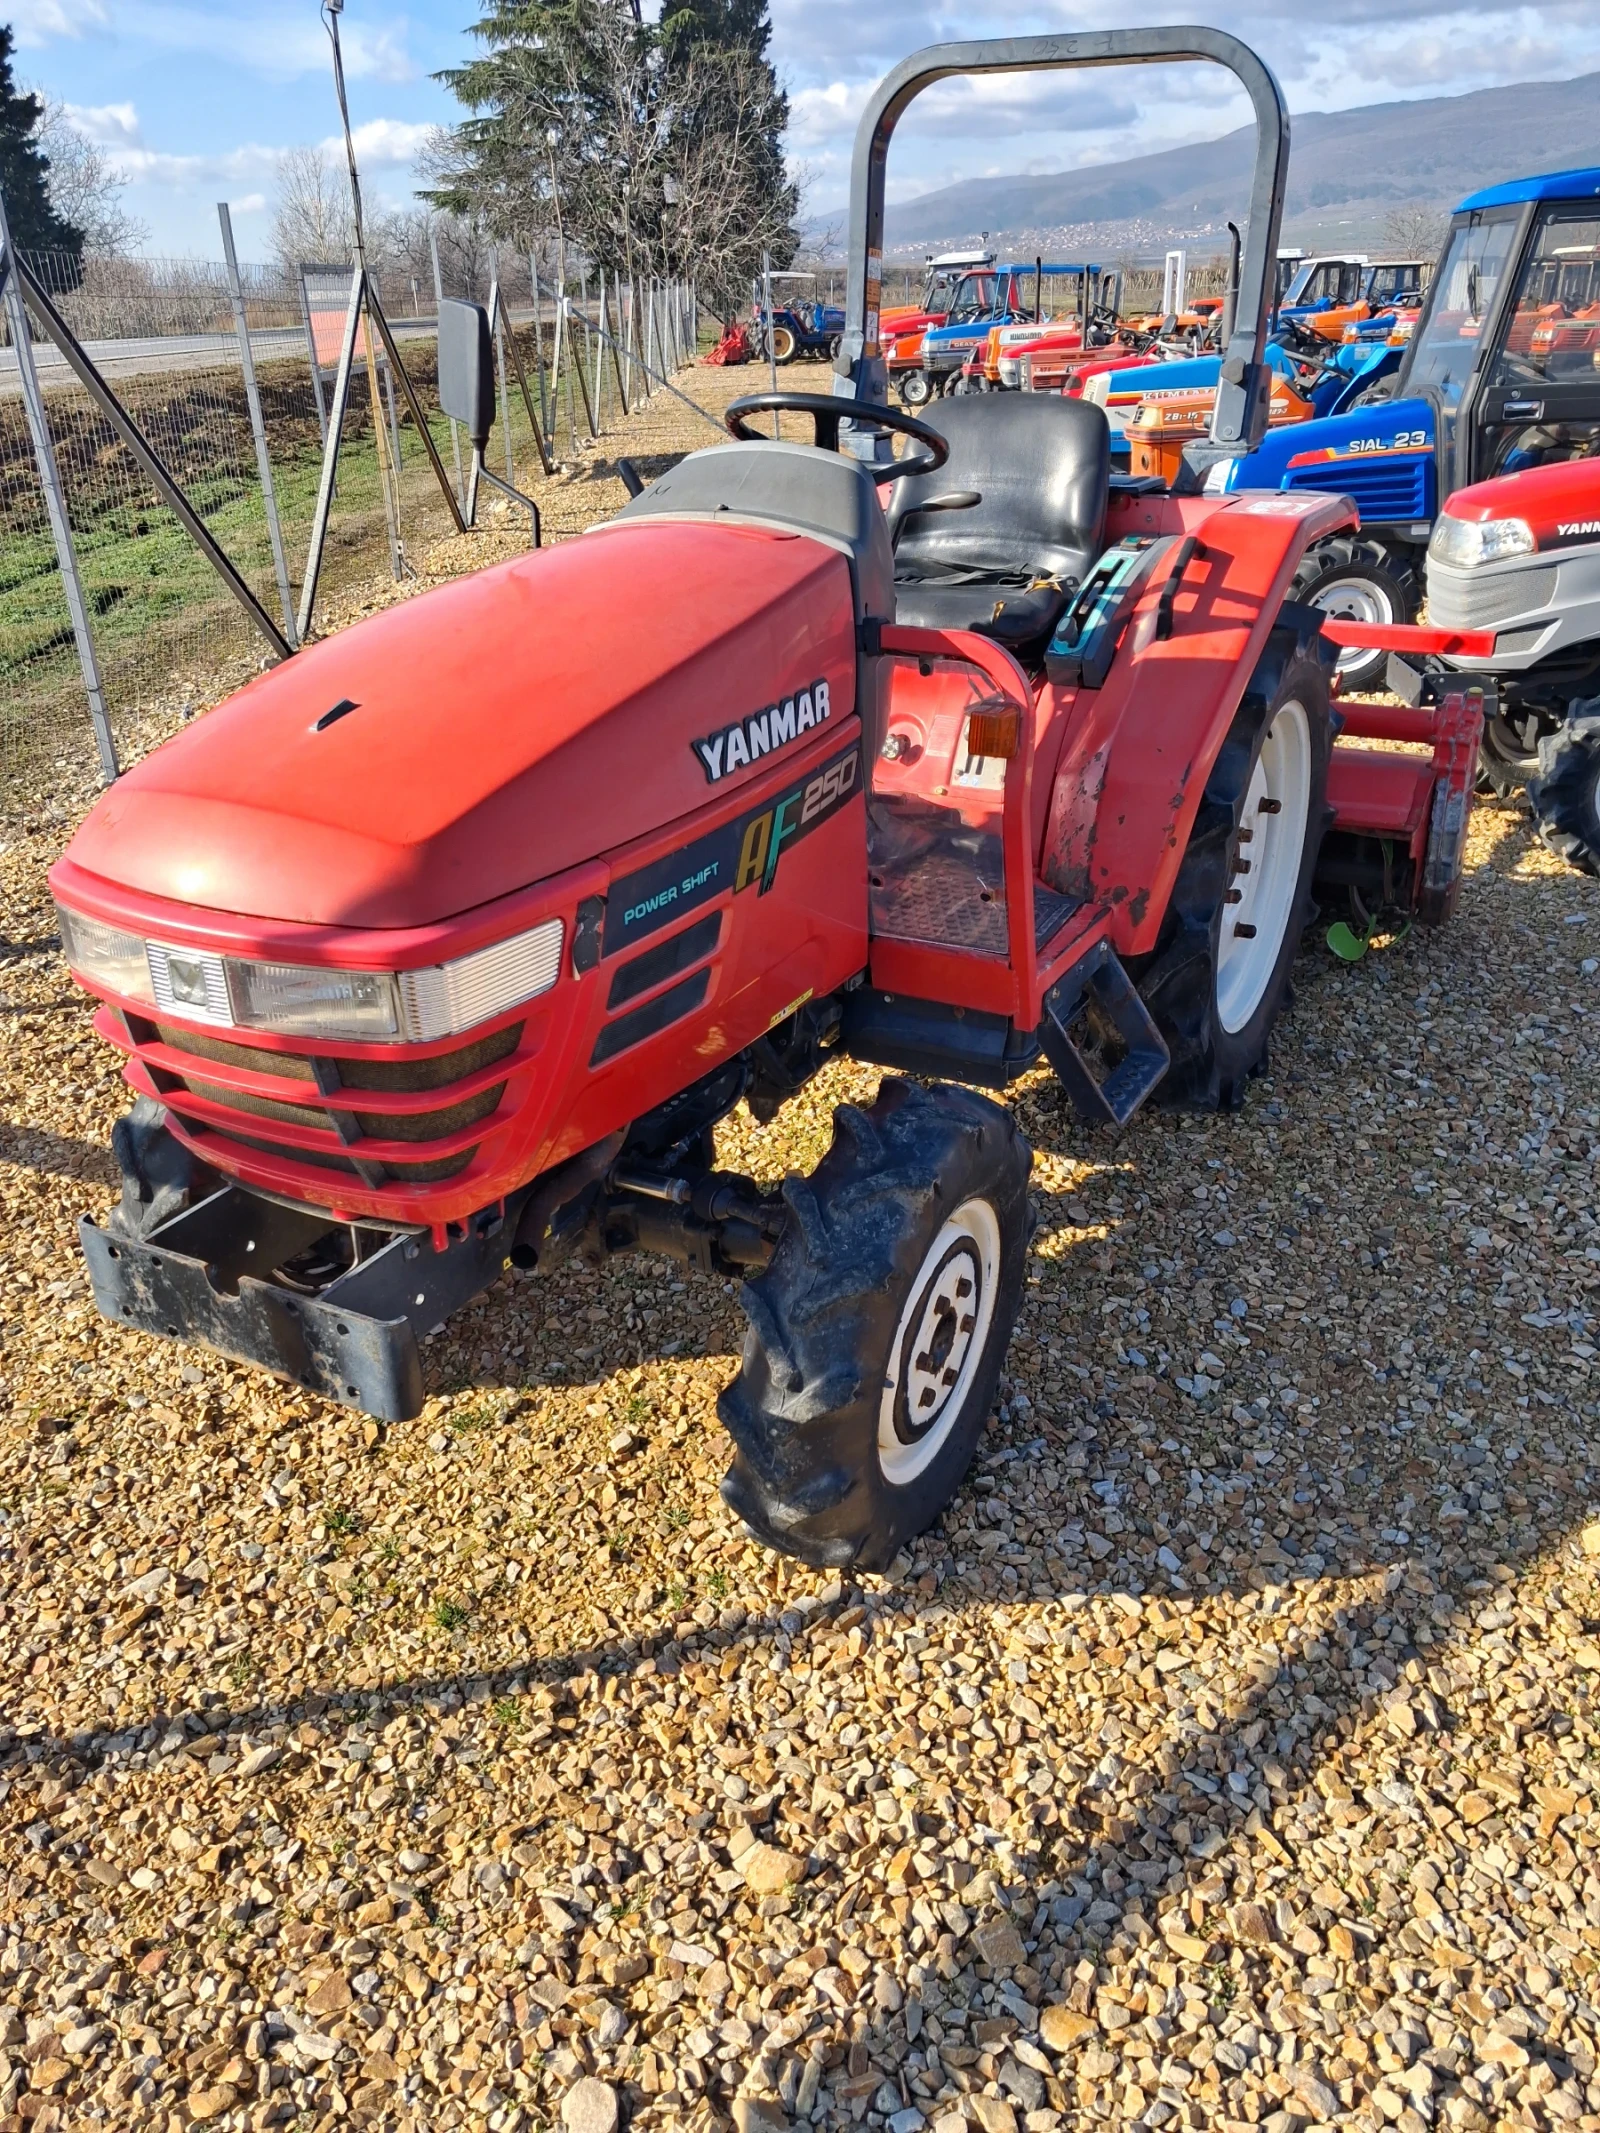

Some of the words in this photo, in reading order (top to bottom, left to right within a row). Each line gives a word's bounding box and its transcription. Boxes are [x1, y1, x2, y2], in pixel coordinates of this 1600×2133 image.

[1349, 438, 1387, 453] SIAL
[1394, 430, 1426, 448] 23
[696, 679, 832, 784] YANMAR
[624, 887, 678, 926] POWER
[681, 861, 719, 894] SHIFT
